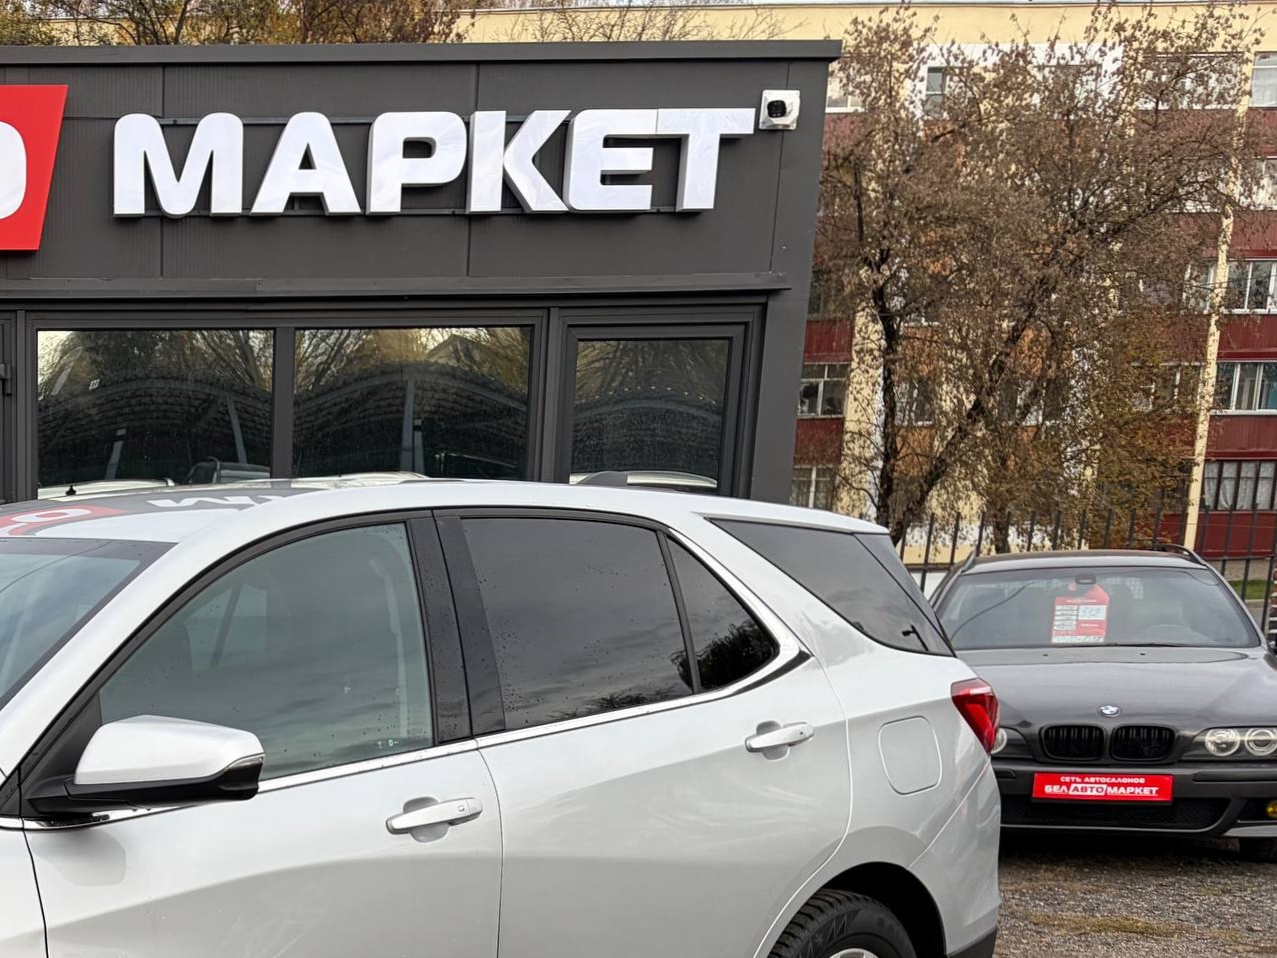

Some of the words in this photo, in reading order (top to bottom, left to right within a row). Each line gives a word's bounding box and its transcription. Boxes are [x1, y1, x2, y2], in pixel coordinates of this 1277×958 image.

[113, 108, 755, 218] МАРКЕТ
[1044, 785, 1068, 794] БЕЛ
[1071, 785, 1105, 794] АВТО
[1106, 786, 1159, 795] МАРКЕТ
